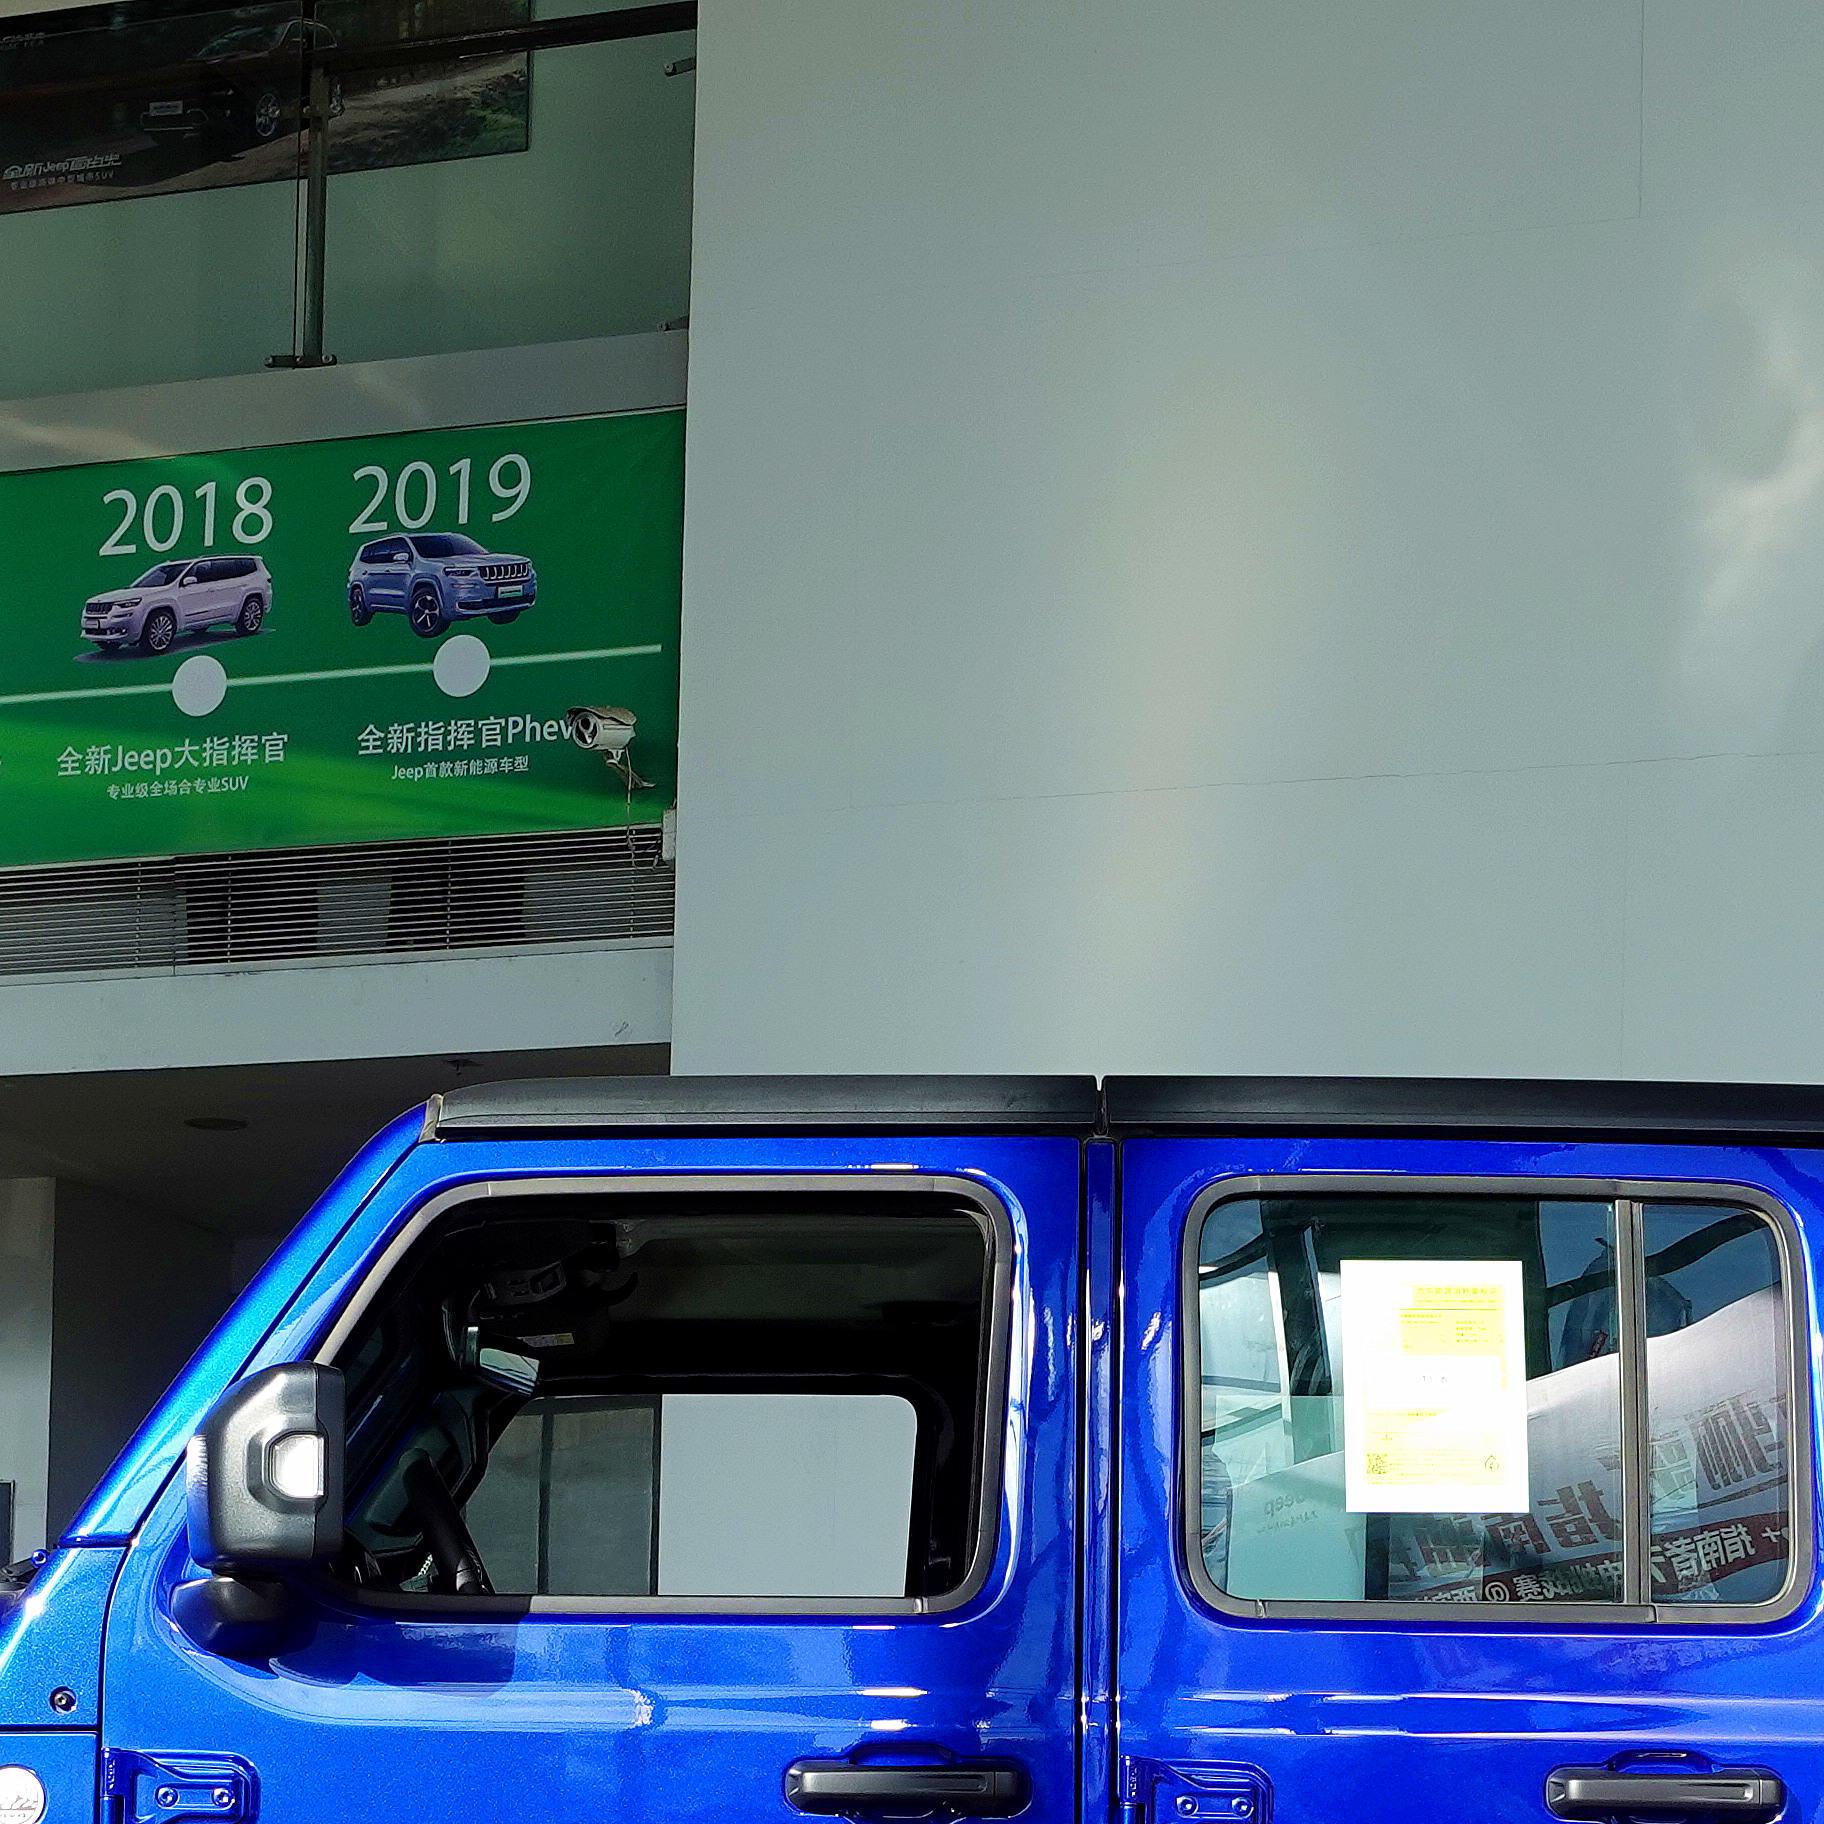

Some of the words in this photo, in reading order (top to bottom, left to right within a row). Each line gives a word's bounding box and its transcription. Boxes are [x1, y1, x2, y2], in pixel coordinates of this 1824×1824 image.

[99, 476, 274, 557] 2018
[348, 452, 531, 535] 2019
[56, 731, 289, 778] 全新Jeep大指挥官
[390, 755, 529, 781] Jeep首款新能源车型
[106, 775, 250, 800] 专业级全场合专业SUV
